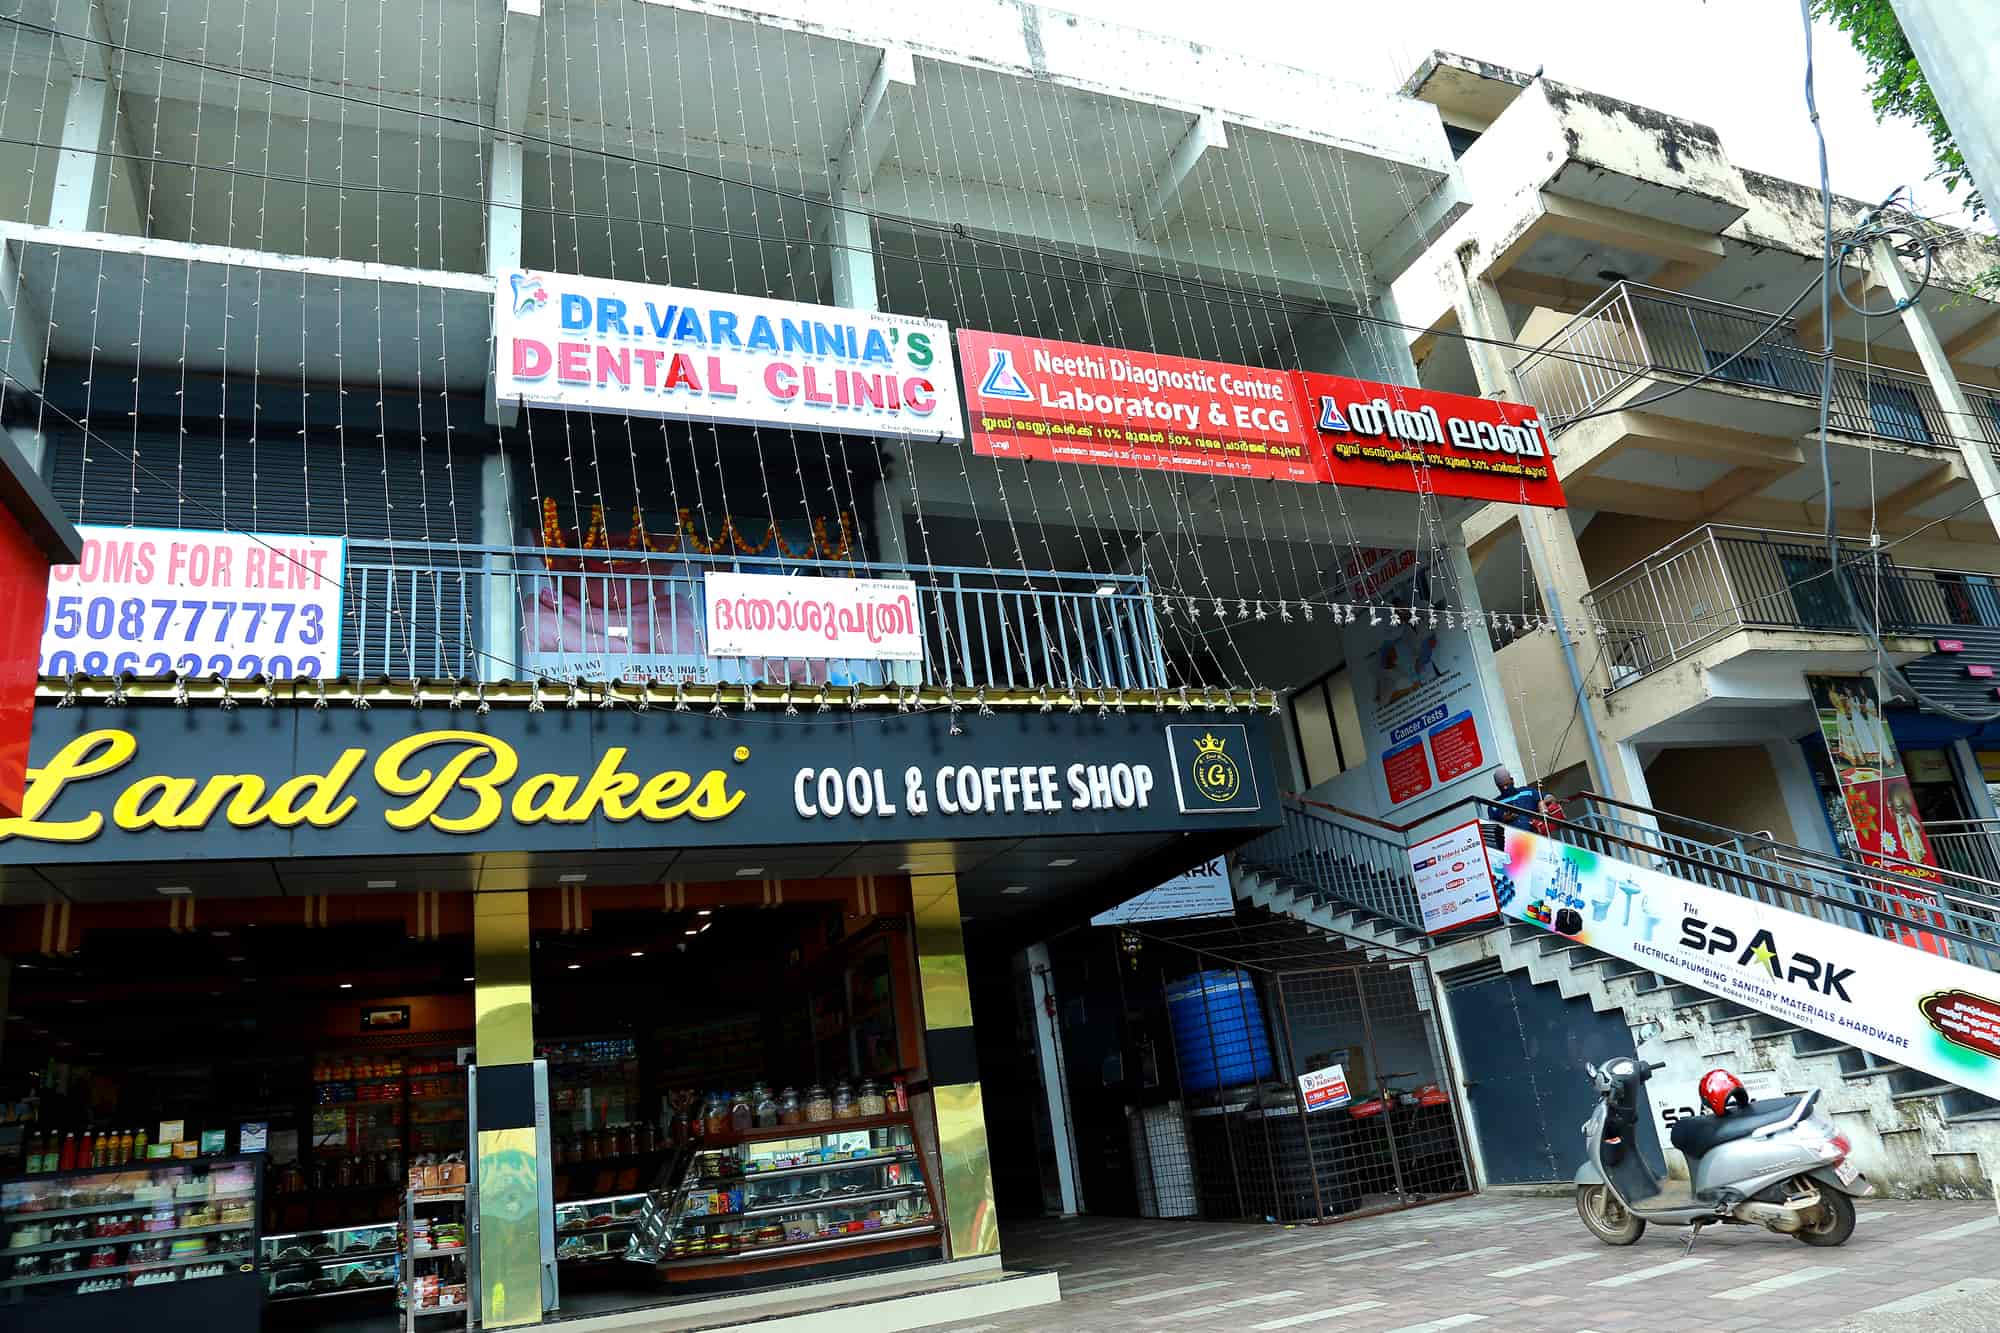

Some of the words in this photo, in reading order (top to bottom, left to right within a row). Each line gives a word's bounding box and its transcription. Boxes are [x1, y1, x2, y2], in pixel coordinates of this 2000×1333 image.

[511, 337, 738, 397] DENTAL
[763, 361, 937, 416] CLINIC
[1033, 349, 1106, 382] Neethi
[1111, 355, 1217, 394] Diagnostic
[1219, 375, 1284, 402] Centre
[1039, 383, 1201, 430] Laboratory
[1207, 402, 1229, 428] &
[1234, 404, 1290, 433] ECG
[1347, 398, 1445, 445] നീതി
[1096, 426, 1122, 440] 10%
[1168, 434, 1192, 447] 50%
[168, 543, 234, 587] FOR
[245, 546, 328, 590] RENT
[43, 596, 324, 645] 508777773
[1394, 723, 1421, 741] Cancer
[1422, 709, 1444, 727] Tests
[0, 729, 367, 842] Land
[373, 729, 746, 834] Bakes
[794, 766, 897, 818] COOL
[904, 766, 929, 816] &
[936, 764, 1062, 816] COFFEE
[1068, 763, 1154, 811] SHOP
[1679, 916, 1857, 1003] SPARK
[1731, 977, 1778, 1001] SANITARY
[1780, 995, 1836, 1023] MATERIALS
